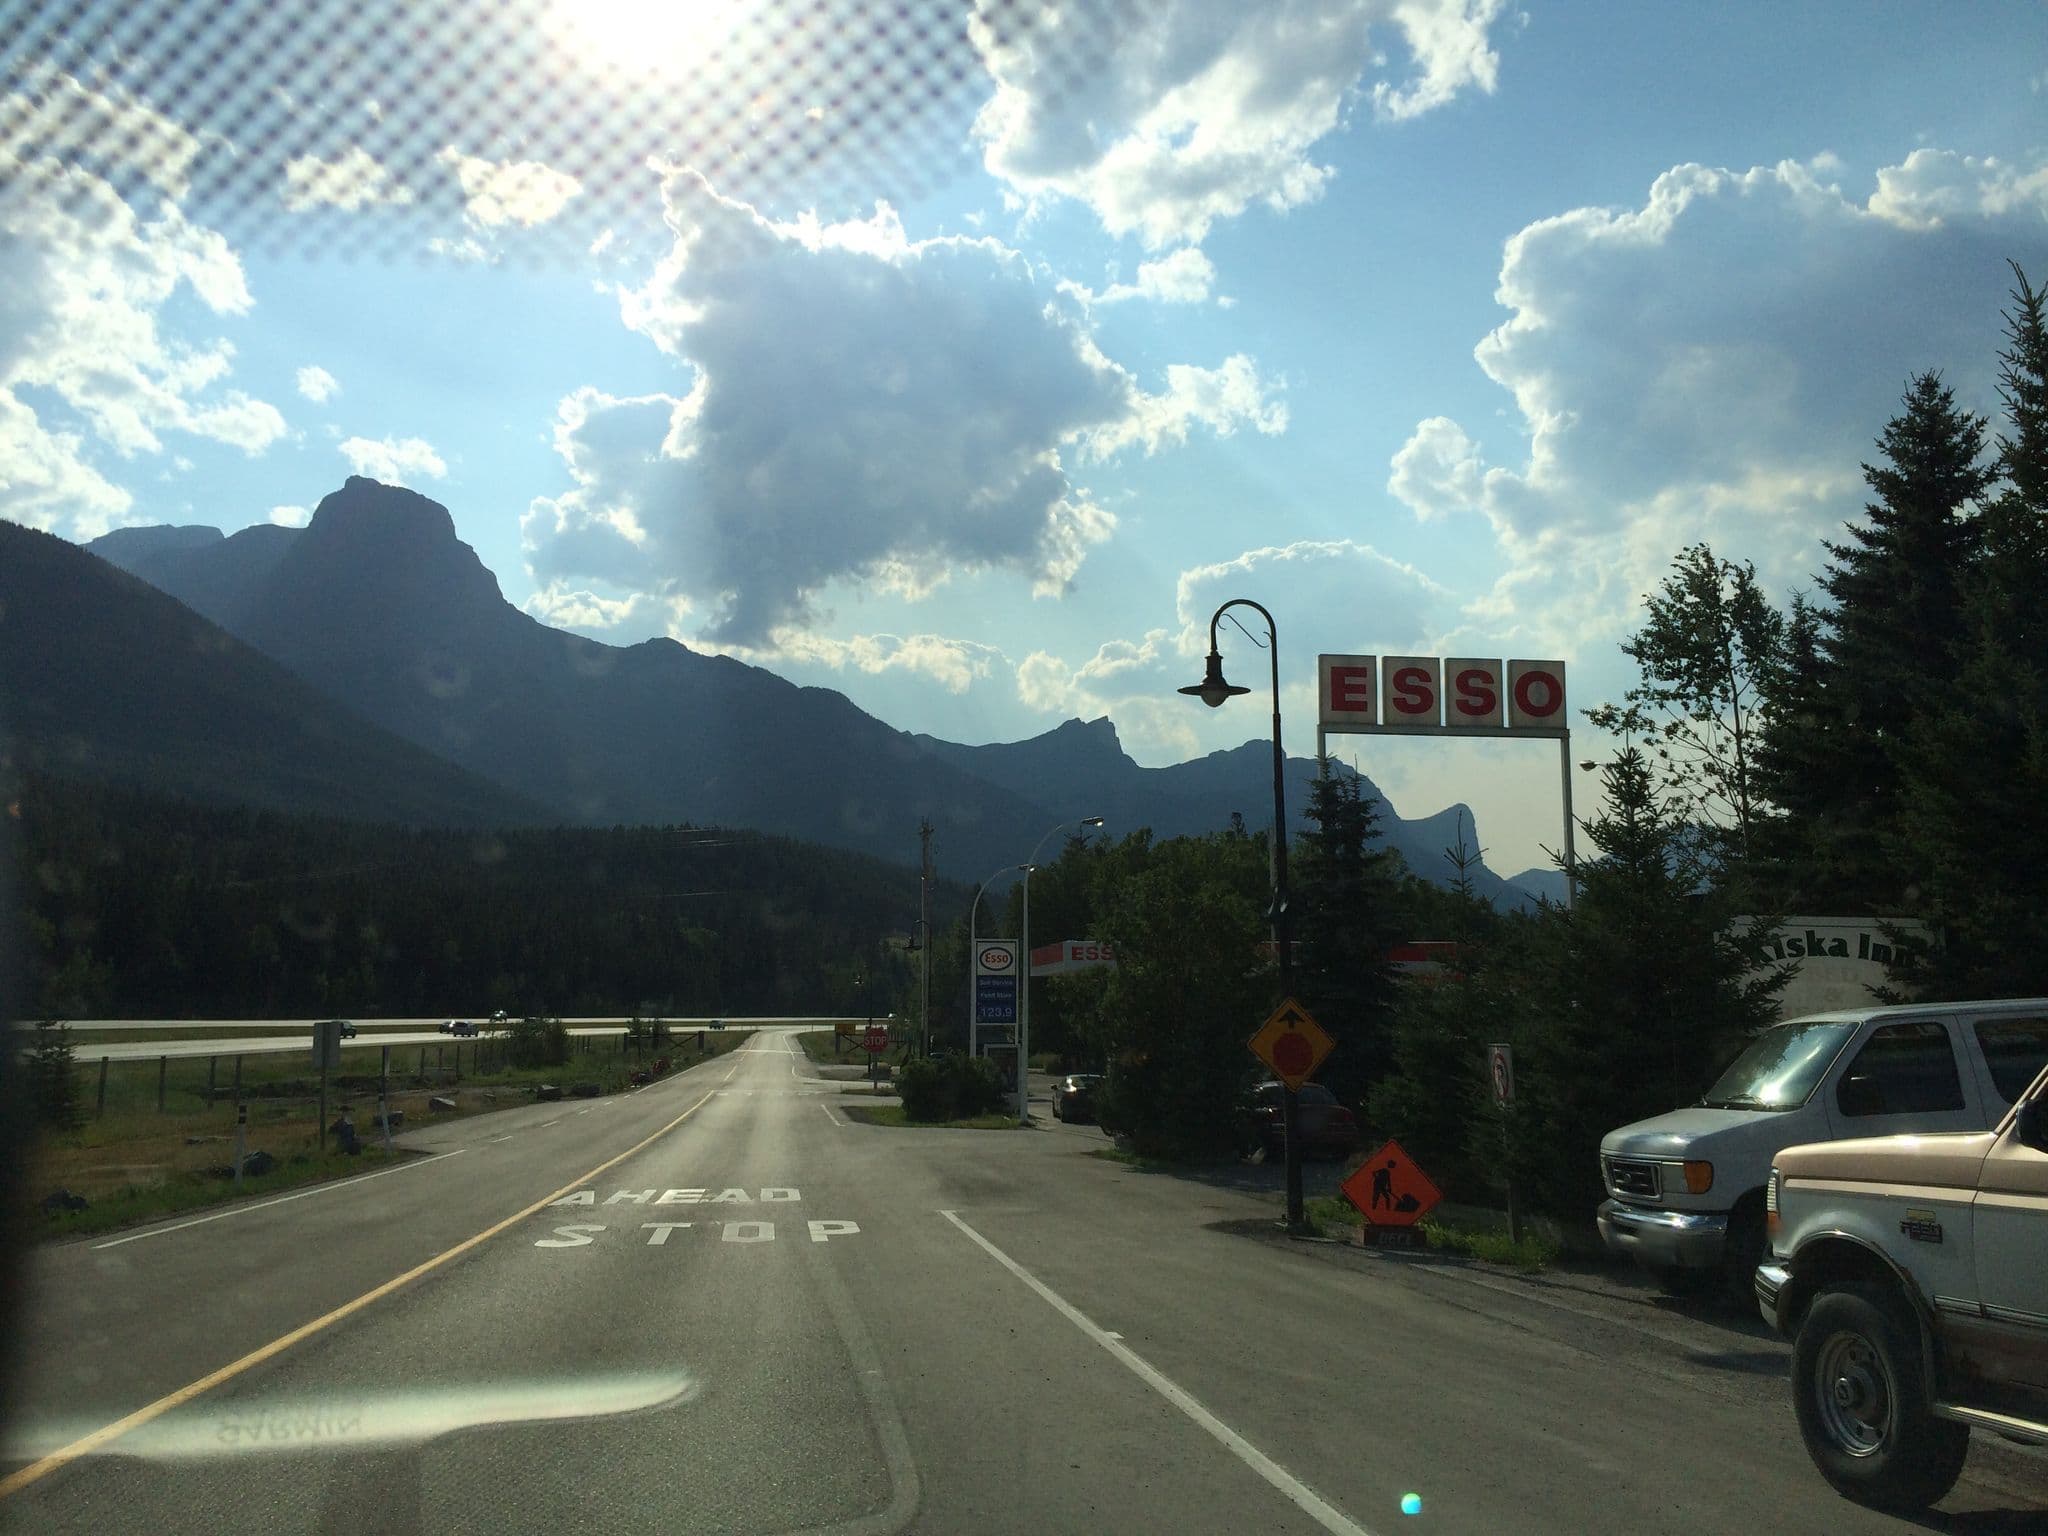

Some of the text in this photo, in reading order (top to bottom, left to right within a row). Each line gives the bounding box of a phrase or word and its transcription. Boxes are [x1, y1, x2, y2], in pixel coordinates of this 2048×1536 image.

[1331, 666, 1563, 718] ESSO
[864, 1035, 887, 1046] STOP
[551, 1187, 802, 1206] AHEAD
[534, 1219, 861, 1248] STOP
